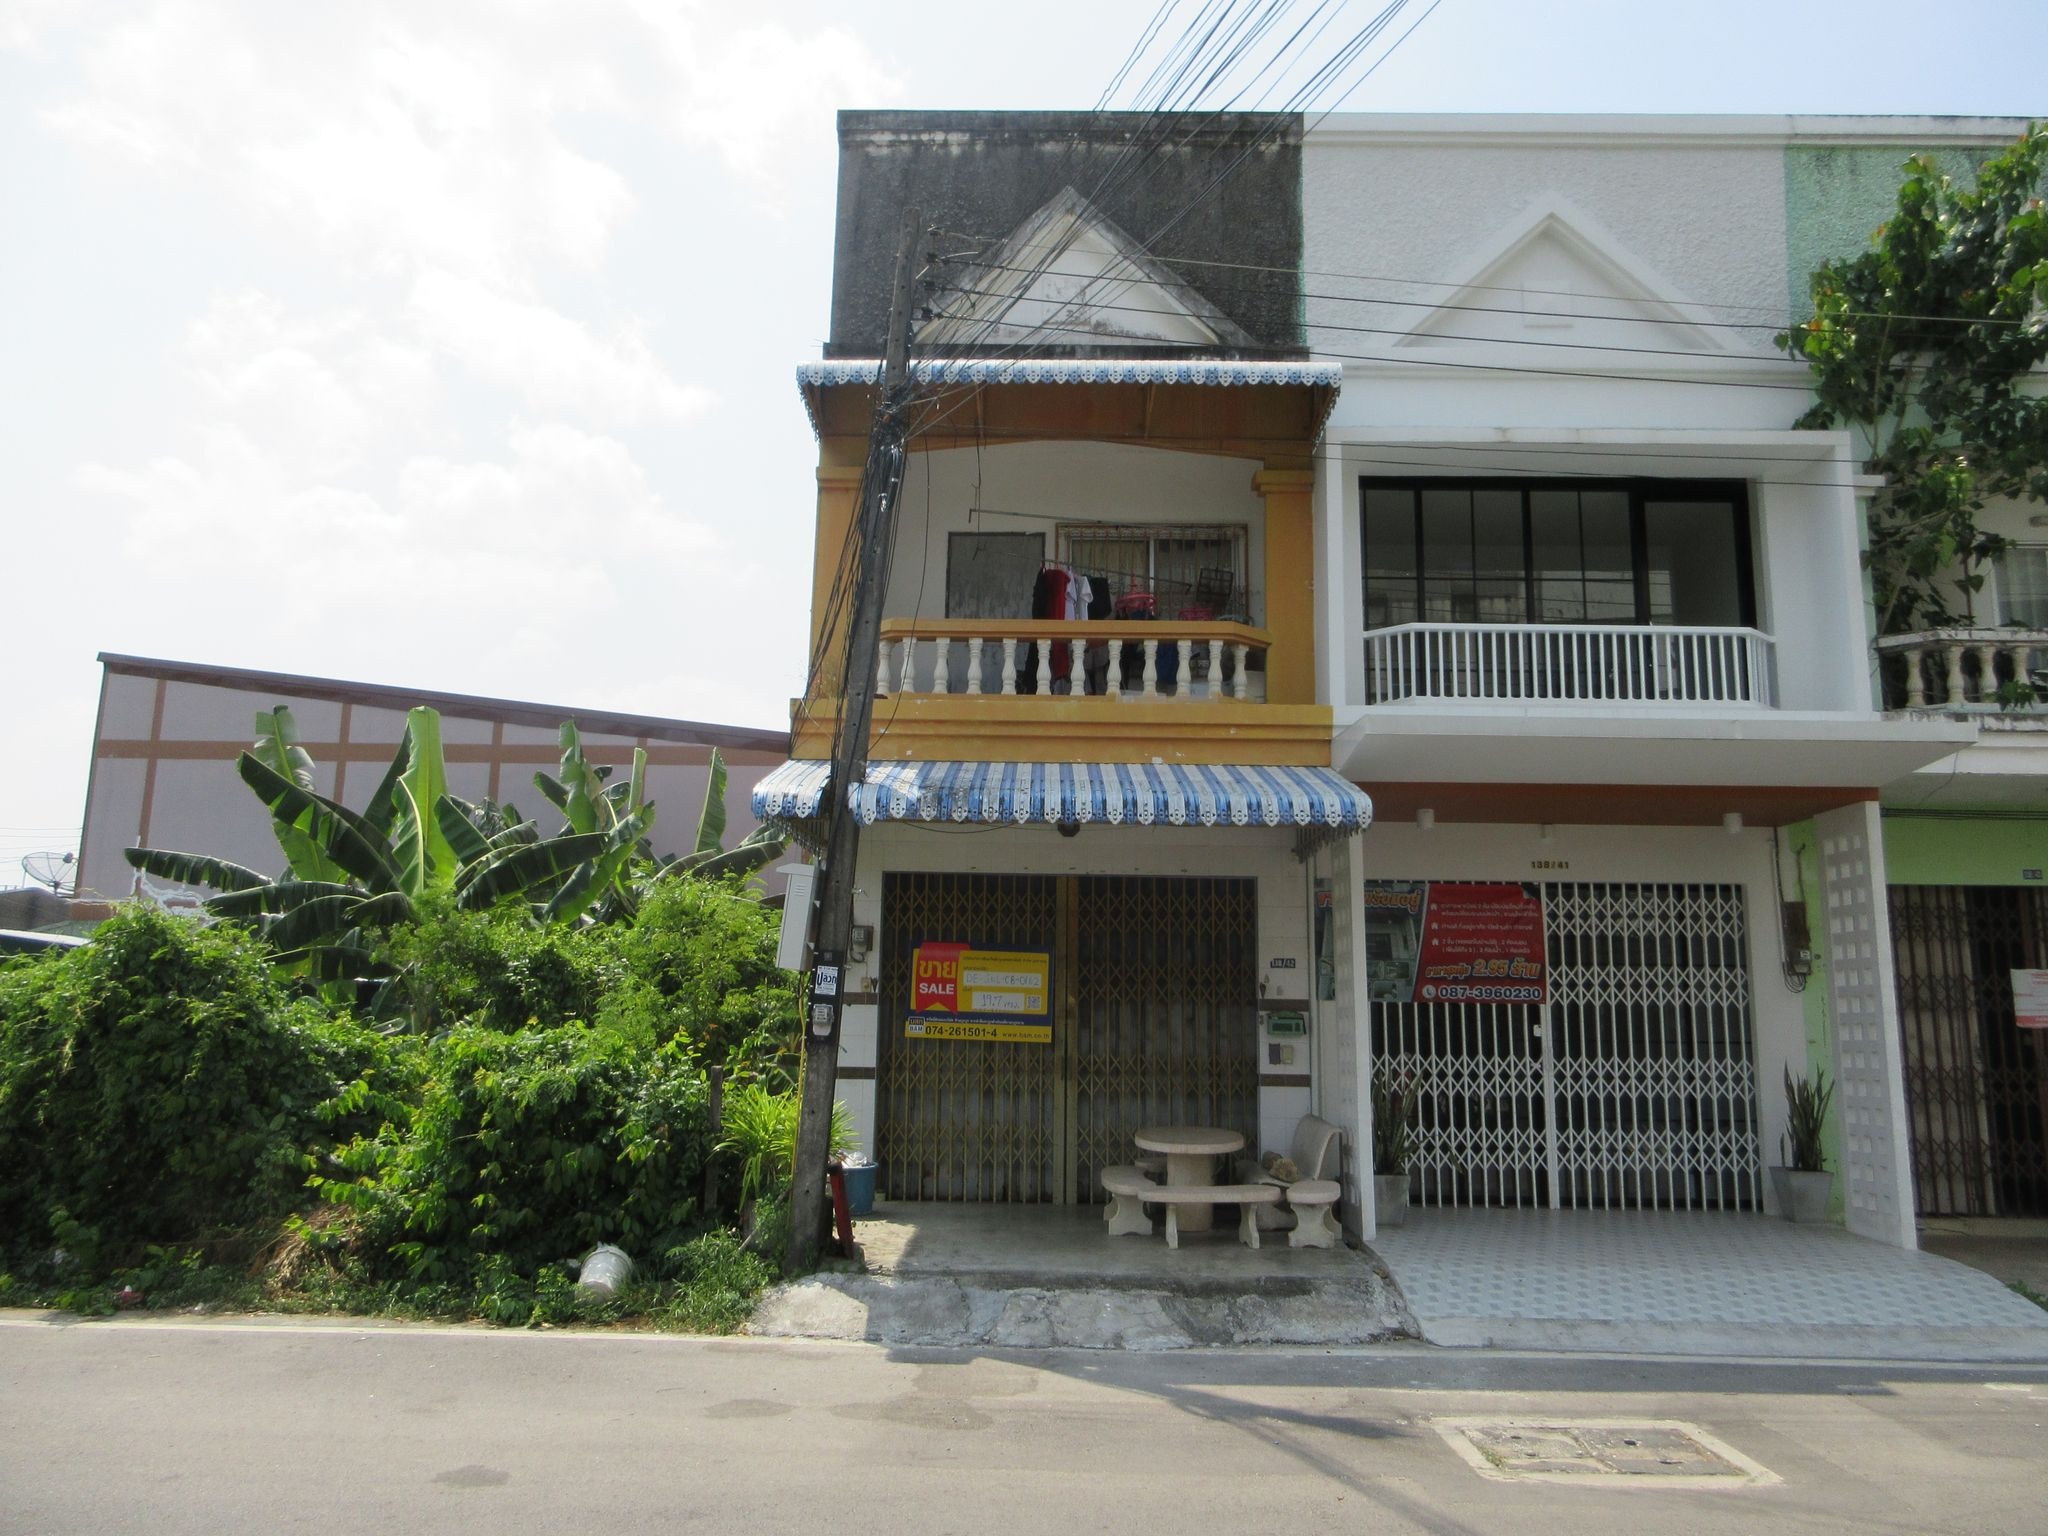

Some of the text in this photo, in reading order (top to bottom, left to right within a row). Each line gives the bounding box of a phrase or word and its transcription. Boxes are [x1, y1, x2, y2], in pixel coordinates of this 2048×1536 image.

[919, 960, 956, 978] ขาย
[1473, 959, 1510, 976] 2.95
[1510, 957, 1541, 978] ล้าน
[817, 971, 837, 986] ปลวก
[919, 982, 954, 995] SALE
[1440, 986, 1542, 999] 087-3960230
[925, 1025, 997, 1038] 074-261501-4
